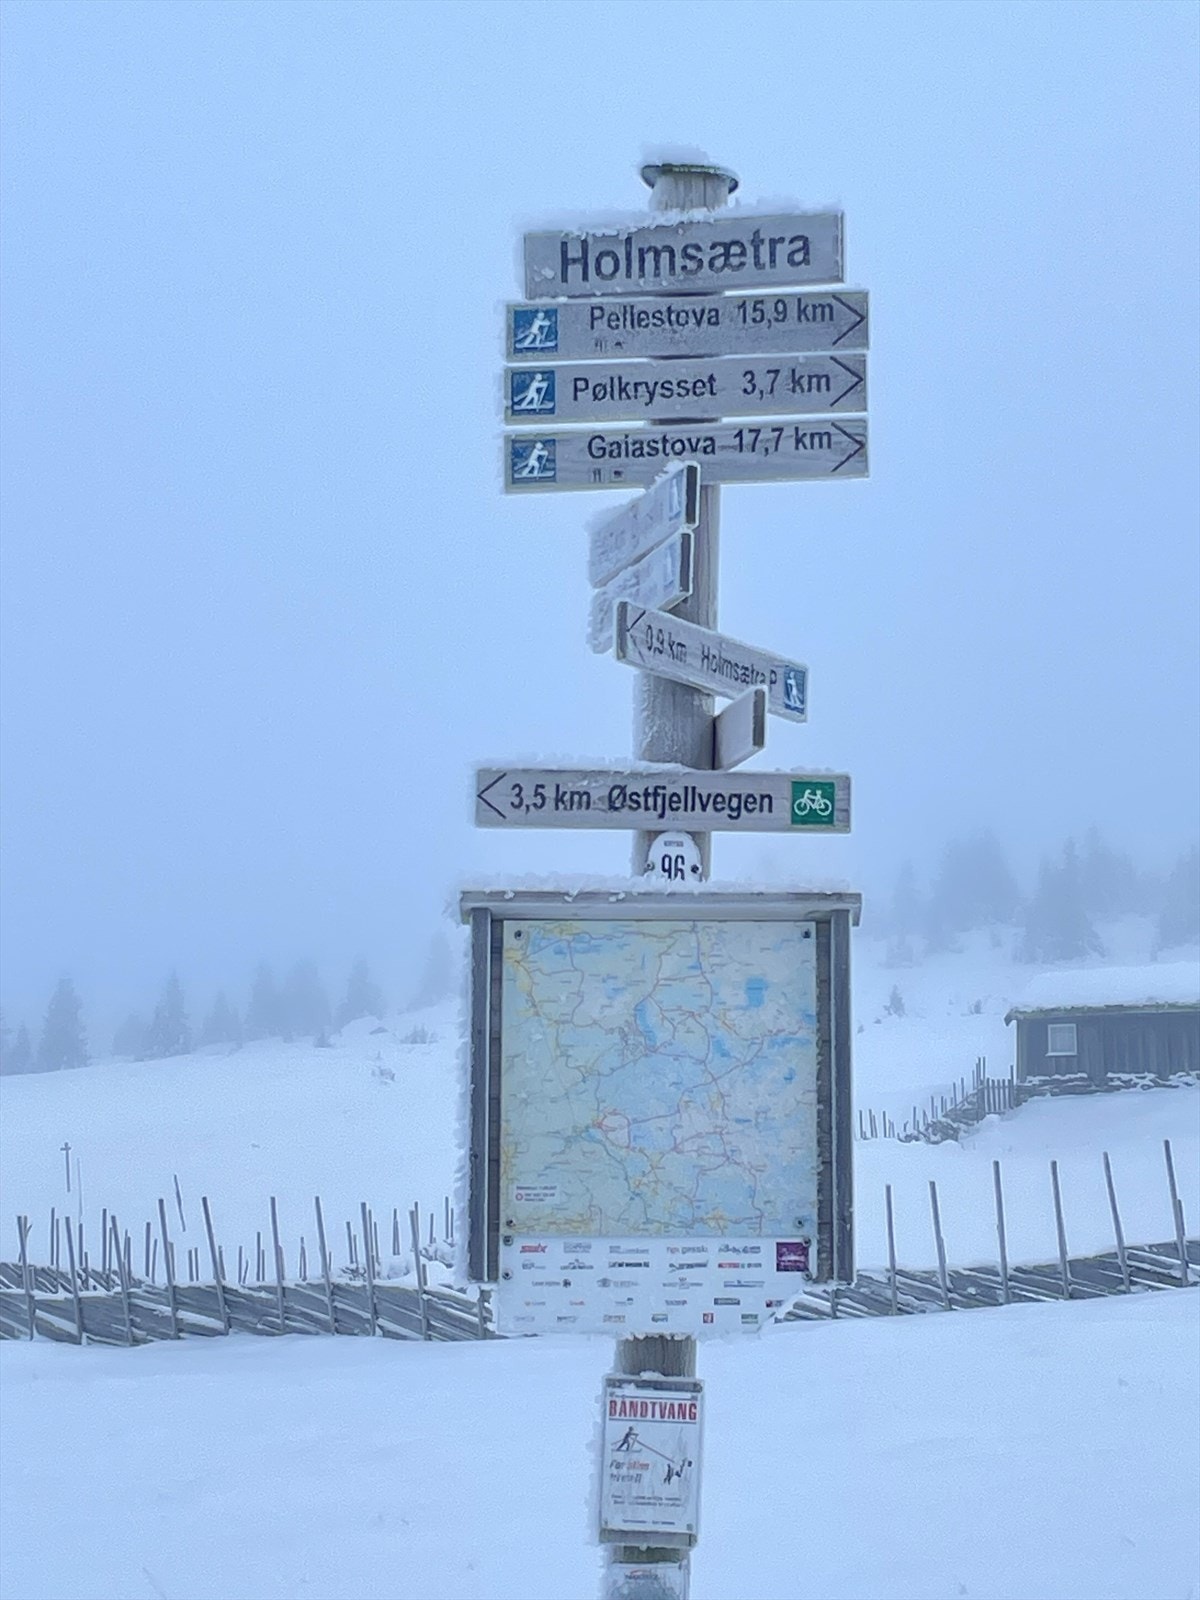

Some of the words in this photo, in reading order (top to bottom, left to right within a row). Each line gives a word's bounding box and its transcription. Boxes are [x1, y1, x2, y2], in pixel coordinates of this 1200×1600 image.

[560, 228, 812, 283] Holmsætra
[589, 304, 721, 331] Pellestova
[737, 299, 788, 329] 15,9
[797, 298, 835, 323] km
[572, 373, 717, 406] Pølkrysset
[742, 370, 781, 400] 3,7
[791, 368, 831, 394] km
[587, 434, 717, 460] Gaiastova
[733, 428, 785, 457] 17,7
[795, 426, 832, 451] km
[645, 624, 664, 655] 0,9
[668, 631, 687, 663] km
[701, 644, 766, 685] Holmsætra
[511, 784, 547, 814] 3,5
[554, 785, 591, 811] km
[607, 784, 774, 820] Østfjellvegen
[661, 854, 686, 881] 96
[608, 1394, 698, 1421] BÅNDTVANG
